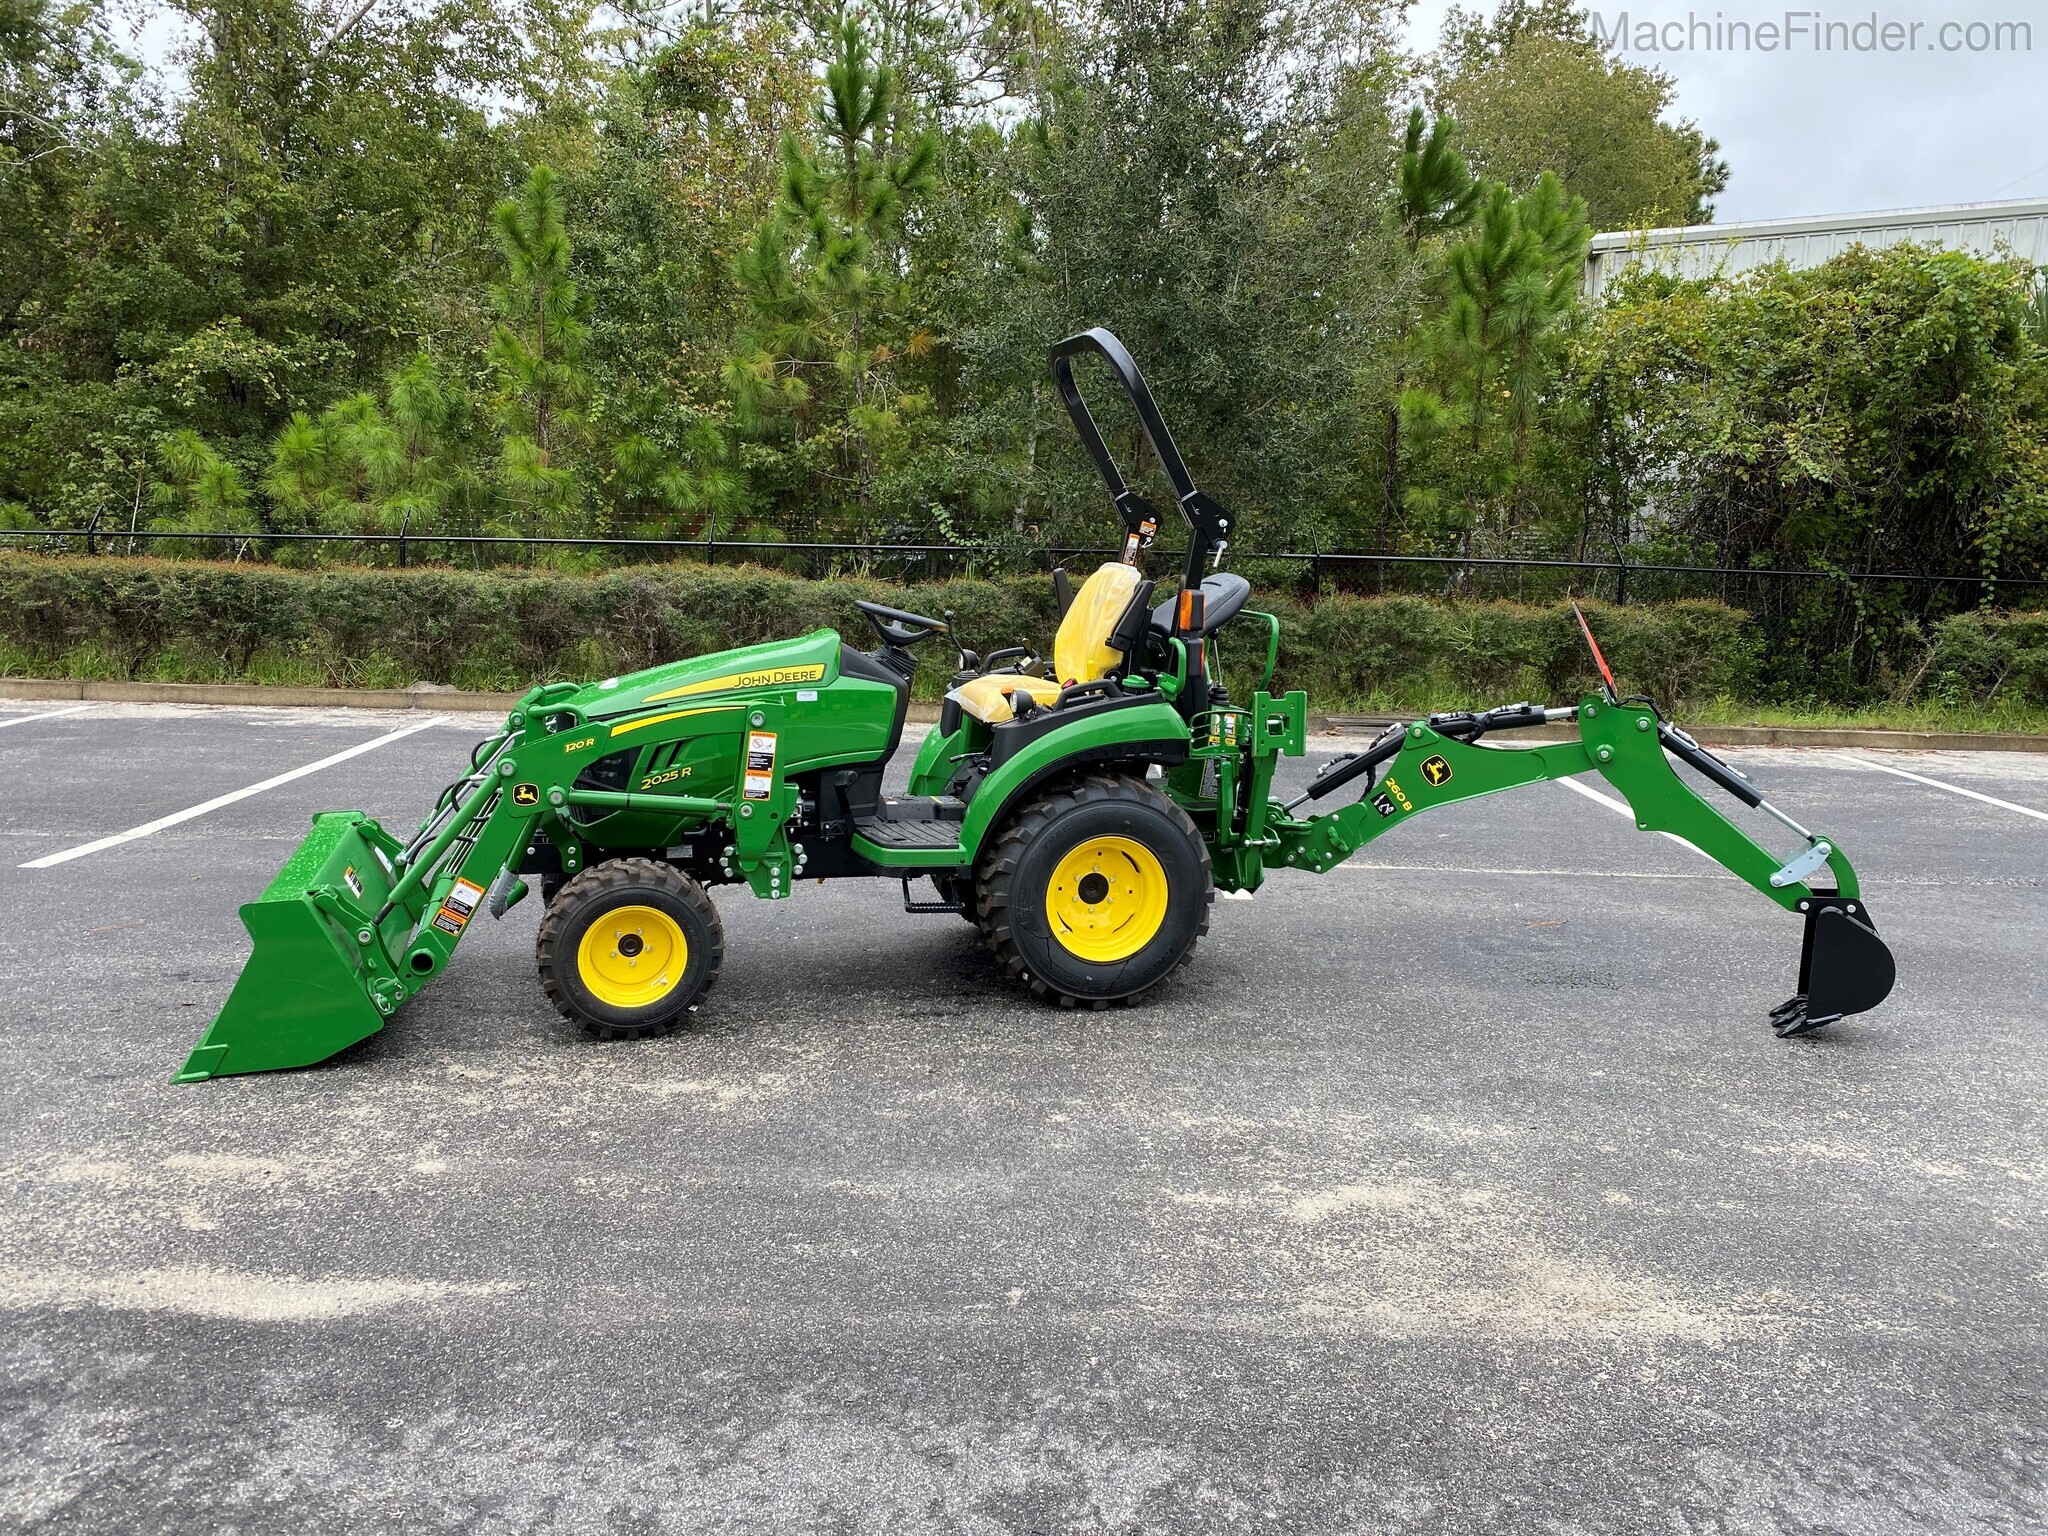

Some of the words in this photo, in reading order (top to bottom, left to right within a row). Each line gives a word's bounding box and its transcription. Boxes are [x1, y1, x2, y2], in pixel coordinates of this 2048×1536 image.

[734, 674, 771, 687] JOHN
[774, 671, 817, 682] DEERE
[565, 740, 585, 753] 120
[586, 738, 595, 747] R
[641, 770, 679, 790] 2025
[682, 767, 692, 778] R
[1385, 777, 1406, 802] 260
[1402, 801, 1413, 811] B
